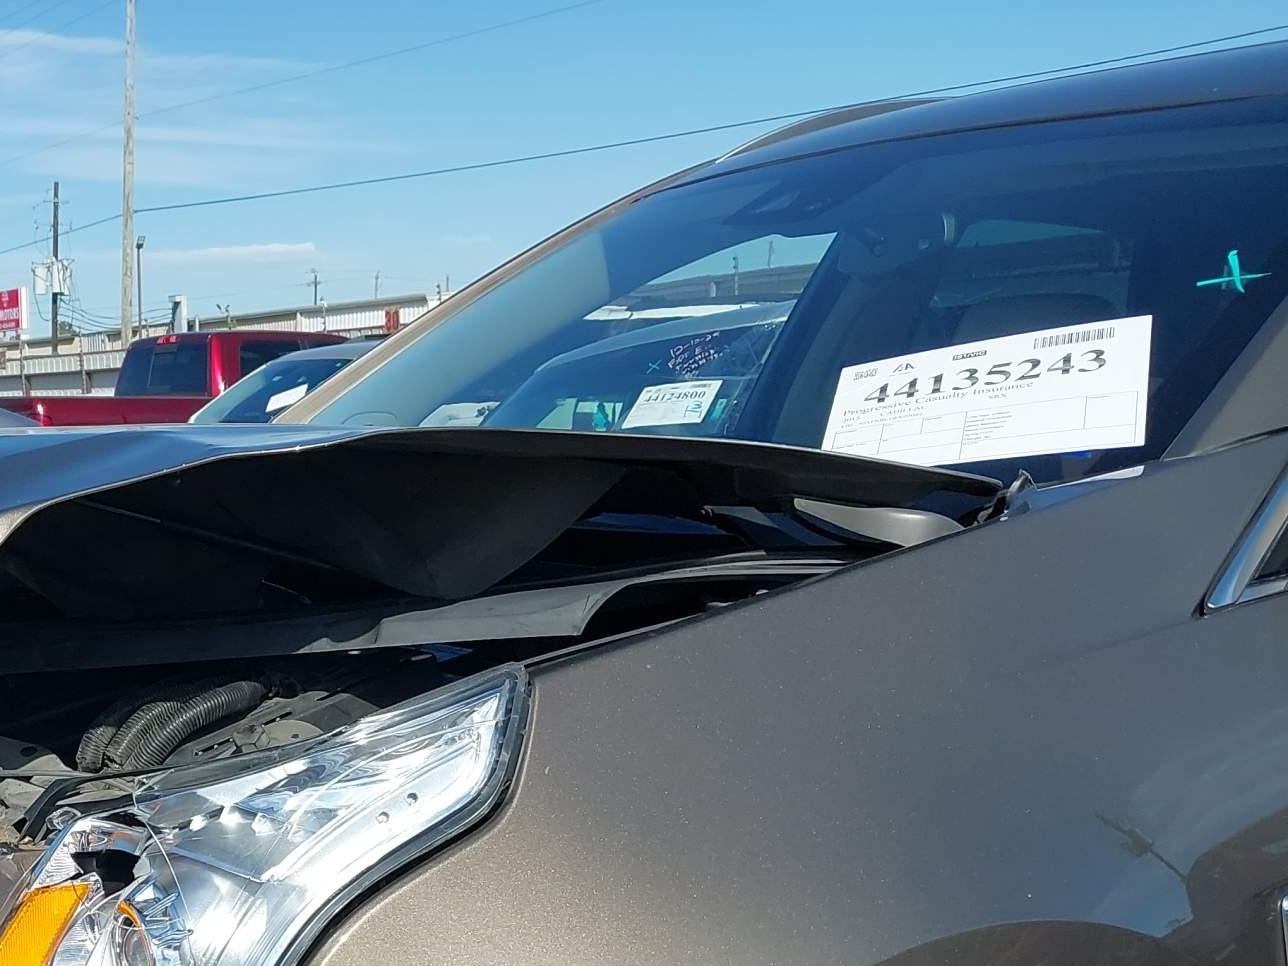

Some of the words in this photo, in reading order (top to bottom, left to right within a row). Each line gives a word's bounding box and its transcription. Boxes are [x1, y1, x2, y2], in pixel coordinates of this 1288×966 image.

[864, 349, 1107, 403] 44135243
[843, 400, 911, 416] Progressive
[915, 391, 968, 405] Casualty
[973, 381, 1033, 396] Insurance
